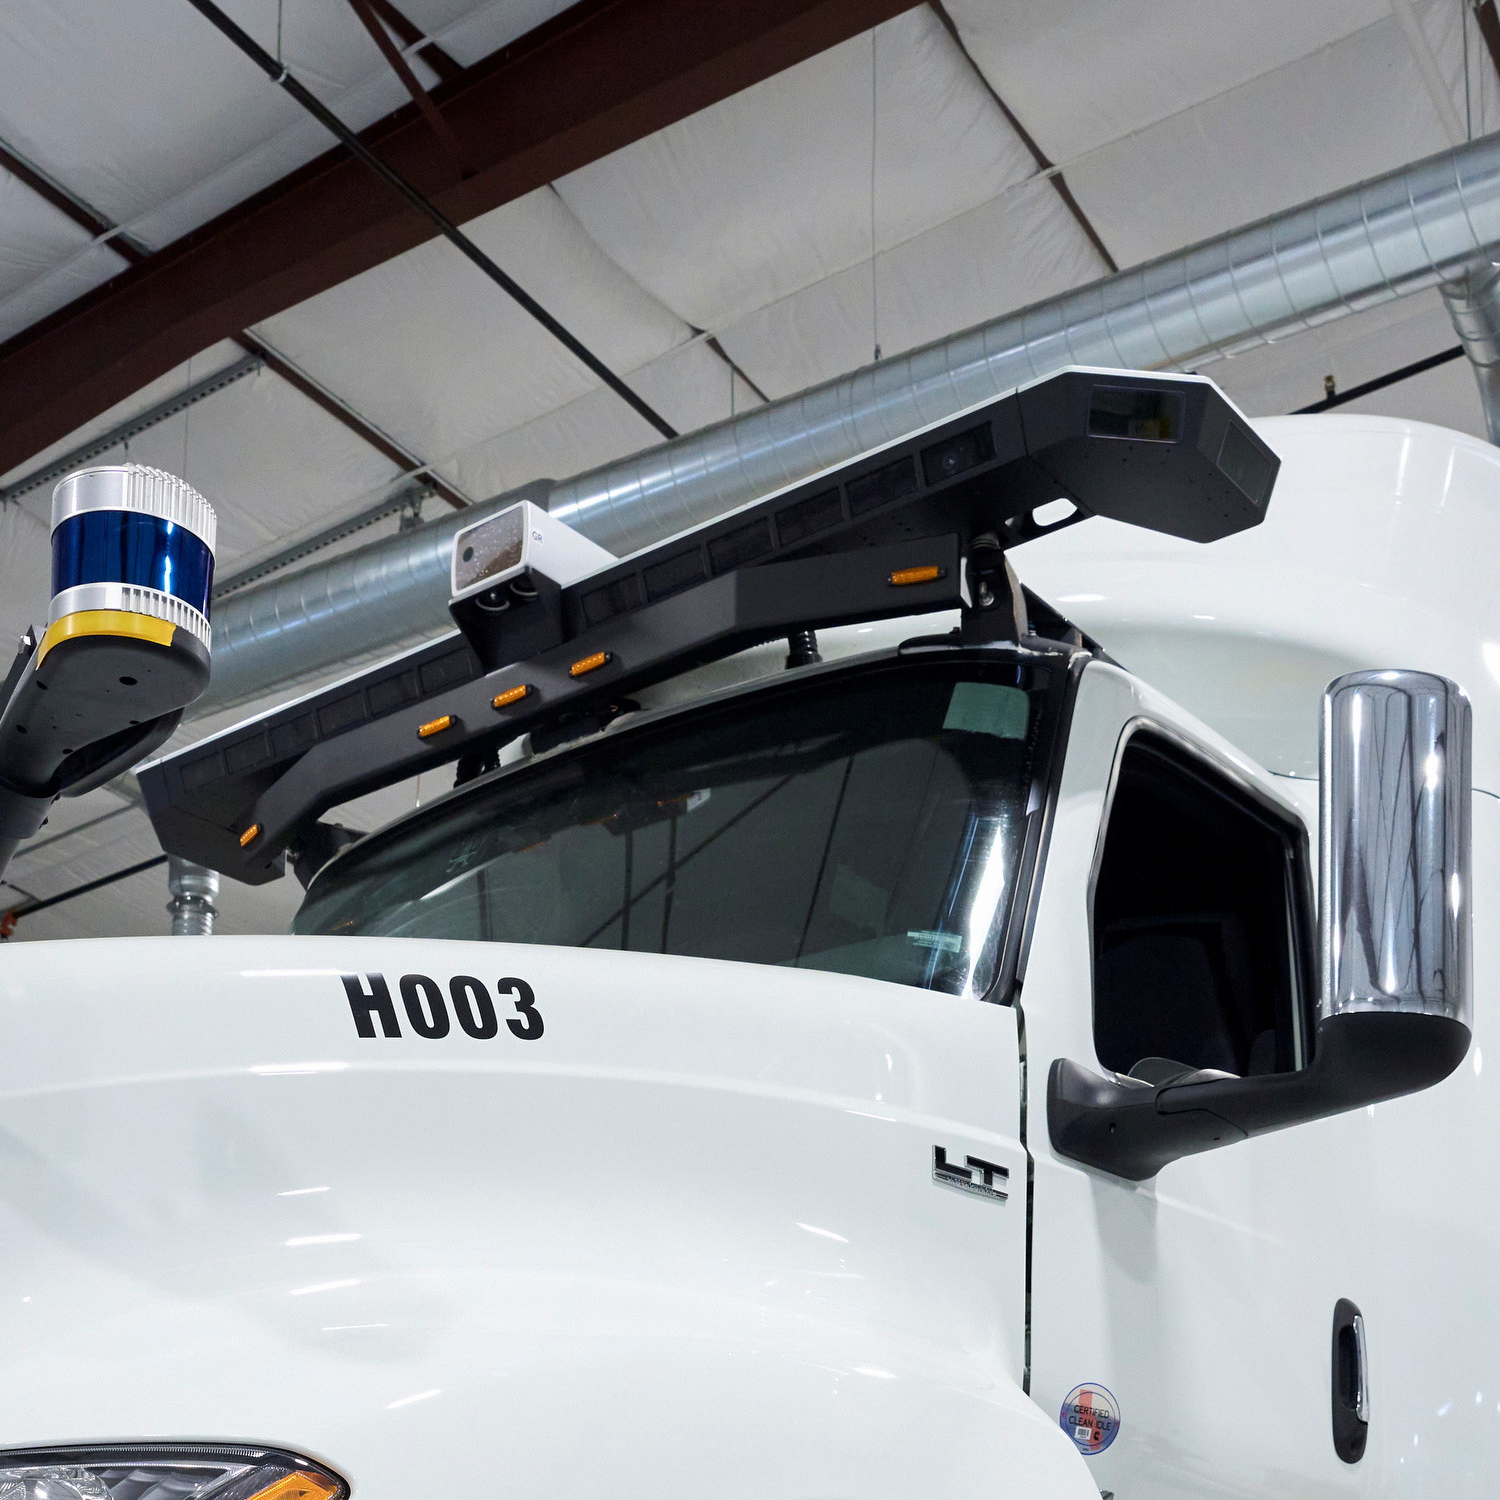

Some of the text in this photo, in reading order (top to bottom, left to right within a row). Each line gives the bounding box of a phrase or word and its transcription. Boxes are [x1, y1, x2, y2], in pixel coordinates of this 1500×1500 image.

[340, 972, 544, 1040] H003
[932, 1145, 1009, 1187] LT
[1068, 1415, 1112, 1431] CLEAN IDLE
[1073, 1404, 1110, 1419] CERTIFIED
